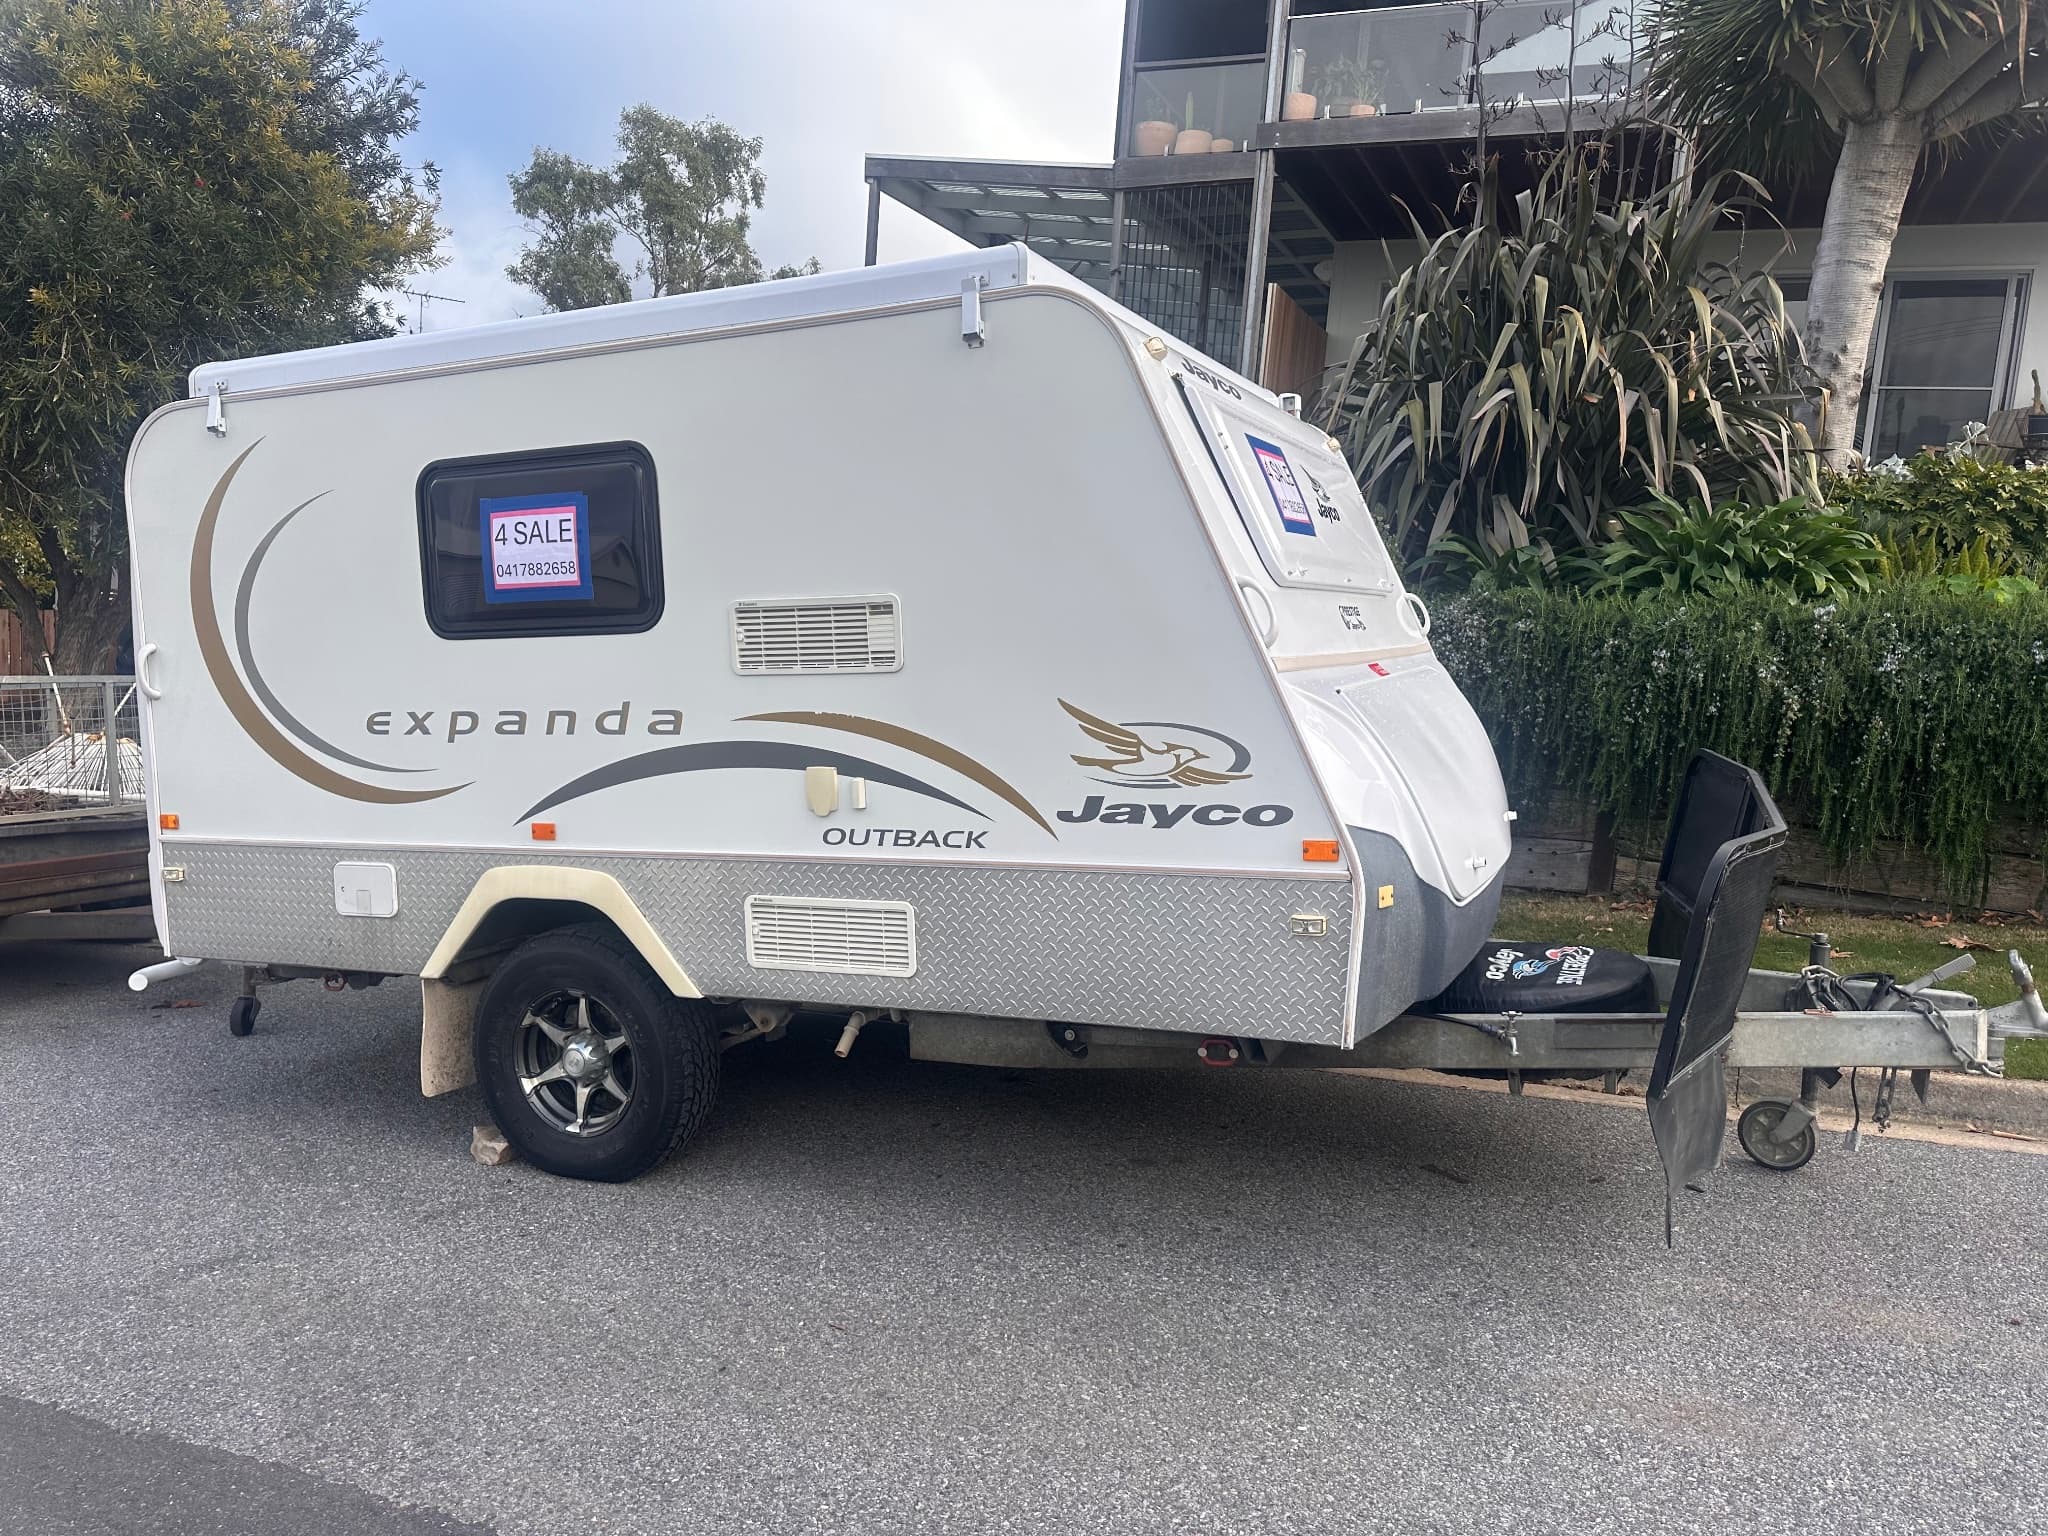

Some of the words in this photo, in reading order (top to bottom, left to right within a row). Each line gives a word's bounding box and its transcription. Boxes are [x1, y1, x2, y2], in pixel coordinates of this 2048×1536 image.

[1181, 357, 1242, 401] Jayco
[1268, 459, 1296, 487] SALE
[1316, 497, 1341, 524] Jayco
[494, 523, 508, 546] 4
[514, 518, 573, 545] SALE
[496, 561, 576, 577] 0417882658
[366, 700, 684, 744] expanda
[1056, 795, 1295, 830] Jayco
[822, 827, 990, 849] OUTBACK
[1485, 948, 1524, 981] Jayco
